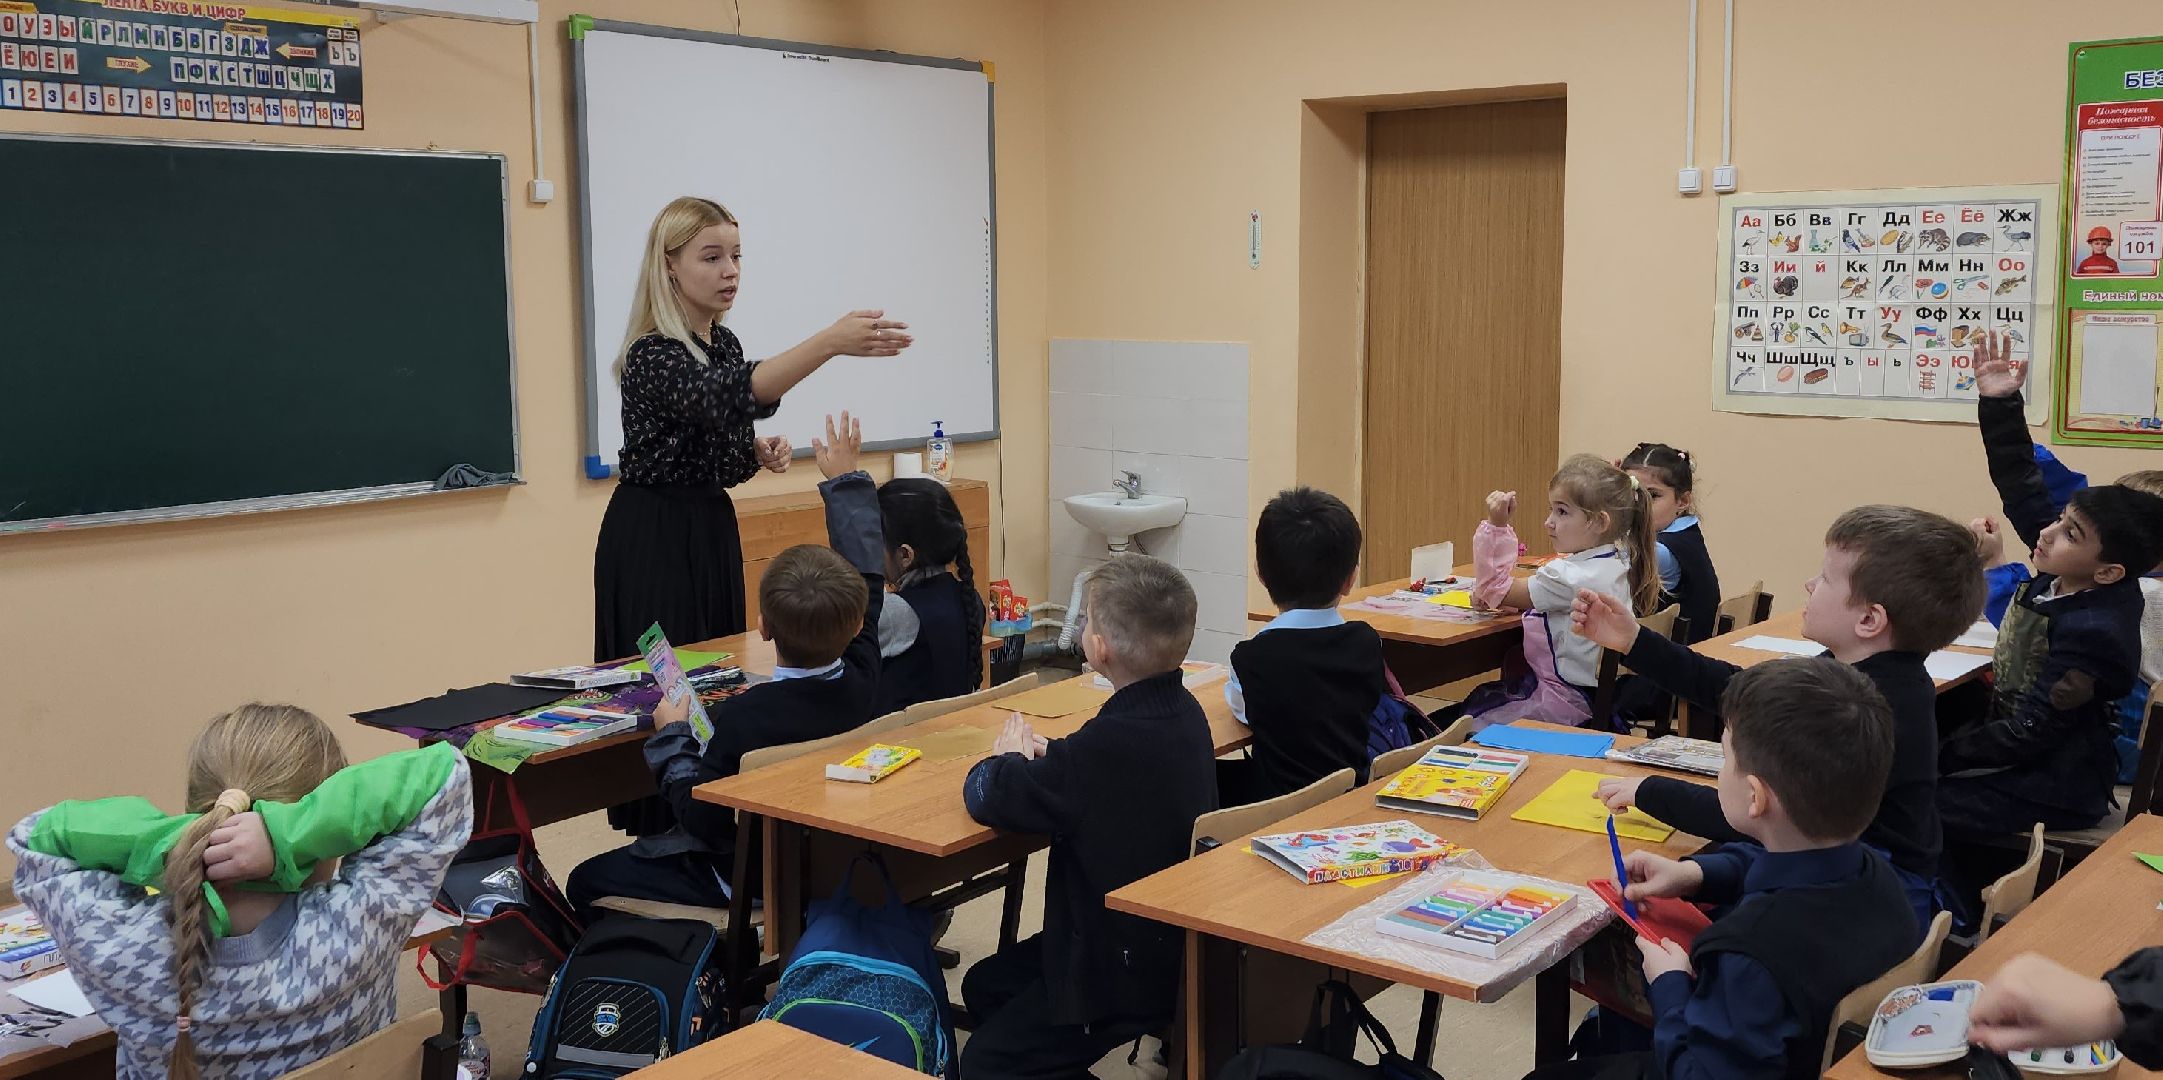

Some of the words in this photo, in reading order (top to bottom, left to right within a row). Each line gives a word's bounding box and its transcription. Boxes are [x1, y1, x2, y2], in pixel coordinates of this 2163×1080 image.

[152, 1, 189, 15] БУКВ
[193, 4, 202, 16] И
[206, 5, 246, 19] ЦИФР
[173, 31, 183, 48] Б
[209, 34, 218, 51] Г
[21, 51, 37, 67] Ю
[45, 51, 55, 69] Е
[174, 62, 185, 79] П
[190, 64, 203, 79] Ф
[209, 65, 219, 81] К
[227, 67, 236, 82] С
[243, 68, 252, 83] Т
[324, 73, 333, 89] Х
[8, 87, 15, 100] 1
[28, 88, 37, 102] 2
[48, 90, 57, 103] 3
[68, 91, 77, 105] 4
[89, 92, 97, 106] 5
[107, 94, 116, 107] 6
[126, 95, 134, 108] 7
[145, 96, 153, 109] 8
[163, 98, 171, 111] 9
[178, 99, 192, 112] 10
[198, 100, 211, 113] 11
[215, 101, 229, 114] 12
[232, 102, 246, 115] 13
[249, 102, 263, 116] 14
[266, 104, 280, 117] 15
[300, 106, 314, 119] 17
[317, 107, 329, 120] 18
[333, 109, 345, 121] 19
[347, 110, 360, 122] 20
[1741, 215, 1762, 228] Аа
[1774, 213, 1797, 227] Бб
[1810, 213, 1832, 227] Вв
[1848, 212, 1867, 227] Гг
[1882, 212, 1911, 228] Дд
[1922, 211, 1946, 224] Ее
[1961, 207, 1985, 223] Ёё
[1998, 209, 2032, 223] Жж
[2124, 241, 2154, 254] 101
[1739, 260, 1760, 273] Зз
[1774, 260, 1797, 273] Ии
[1847, 260, 1868, 273] Кк
[1882, 260, 1907, 273] Лл
[1918, 259, 1949, 272] Мм
[1959, 259, 1984, 272] Нн
[1999, 258, 2026, 272] Оо
[2084, 290, 2137, 301] Единый
[1738, 306, 1759, 319] Пп
[1773, 306, 1795, 322] Рр
[1808, 306, 1829, 319] Сс
[1846, 306, 1866, 319] Тт
[1880, 306, 1902, 322] Уу
[1916, 306, 1948, 322] Фф
[1958, 307, 1981, 320] Хх
[1997, 307, 2024, 322] Цц
[1736, 351, 1756, 364] Чч
[1766, 351, 1799, 364] Шш
[1801, 352, 1836, 368] Щщ
[1916, 354, 1941, 368] Ээ
[1952, 355, 1974, 368] Ю
